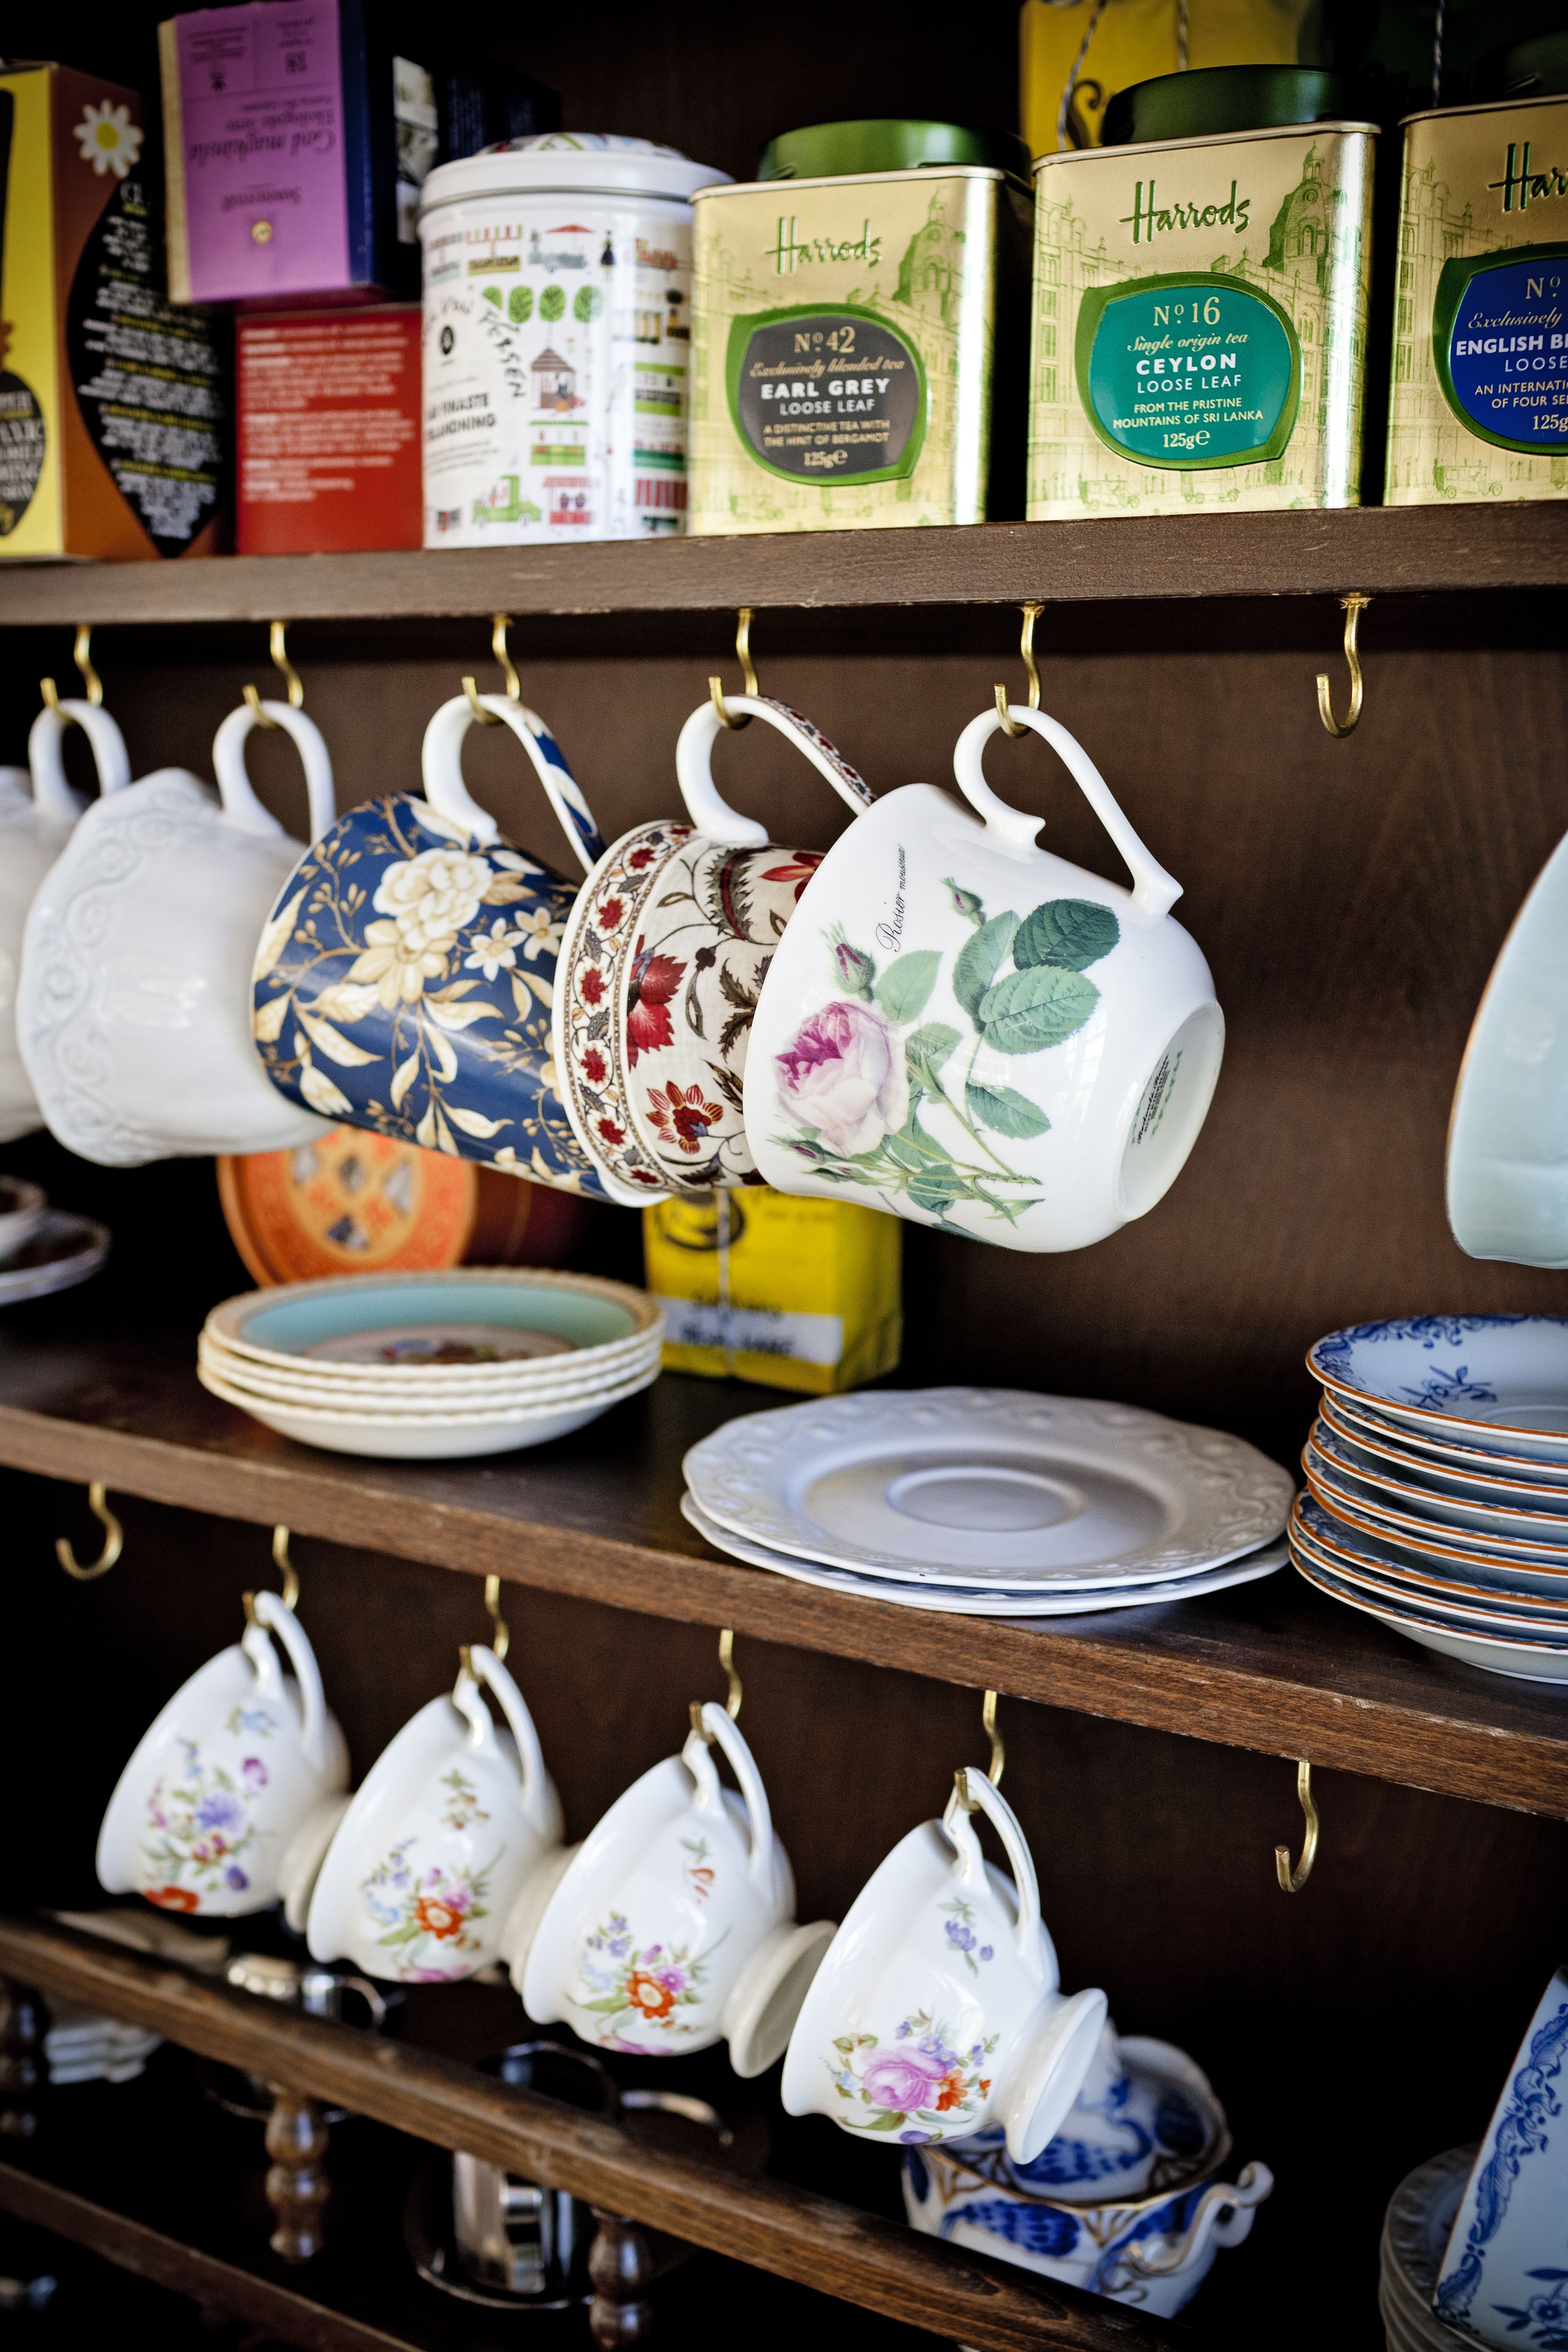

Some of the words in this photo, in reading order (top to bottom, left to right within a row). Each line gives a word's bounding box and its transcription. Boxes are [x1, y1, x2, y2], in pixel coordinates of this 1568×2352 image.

[1487, 141, 1568, 211] Har
[1119, 180, 1251, 244] Harrods
[765, 216, 883, 274] Harrods
[1192, 297, 1221, 325] 16
[1468, 306, 1563, 330] Exclusively
[826, 326, 855, 354] 42
[1127, 334, 1173, 355] Single
[1178, 334, 1221, 352] origin
[1225, 332, 1250, 344] tea
[1456, 335, 1543, 356] ENGLISH
[1136, 353, 1236, 375] CEYLON
[1505, 355, 1568, 372] LOOSE
[761, 381, 819, 400] EARL
[829, 378, 890, 397] GREY
[1137, 375, 1192, 394] LOOSE
[1202, 374, 1242, 389] LEAF
[1474, 384, 1493, 395] AN
[1498, 380, 1568, 394] INTERNATI
[779, 400, 831, 417] LOOSE
[837, 398, 875, 413] LEAF
[1134, 403, 1164, 414] FROM
[1168, 400, 1190, 412] THE
[1192, 397, 1242, 409] PRISTINE
[1491, 398, 1509, 409] OF
[1513, 395, 1548, 408] FOUR
[1113, 416, 1181, 429] MOUNTAINS
[1184, 414, 1200, 425] OF
[1203, 412, 1220, 422] SRI
[1224, 410, 1264, 421] LANKA
